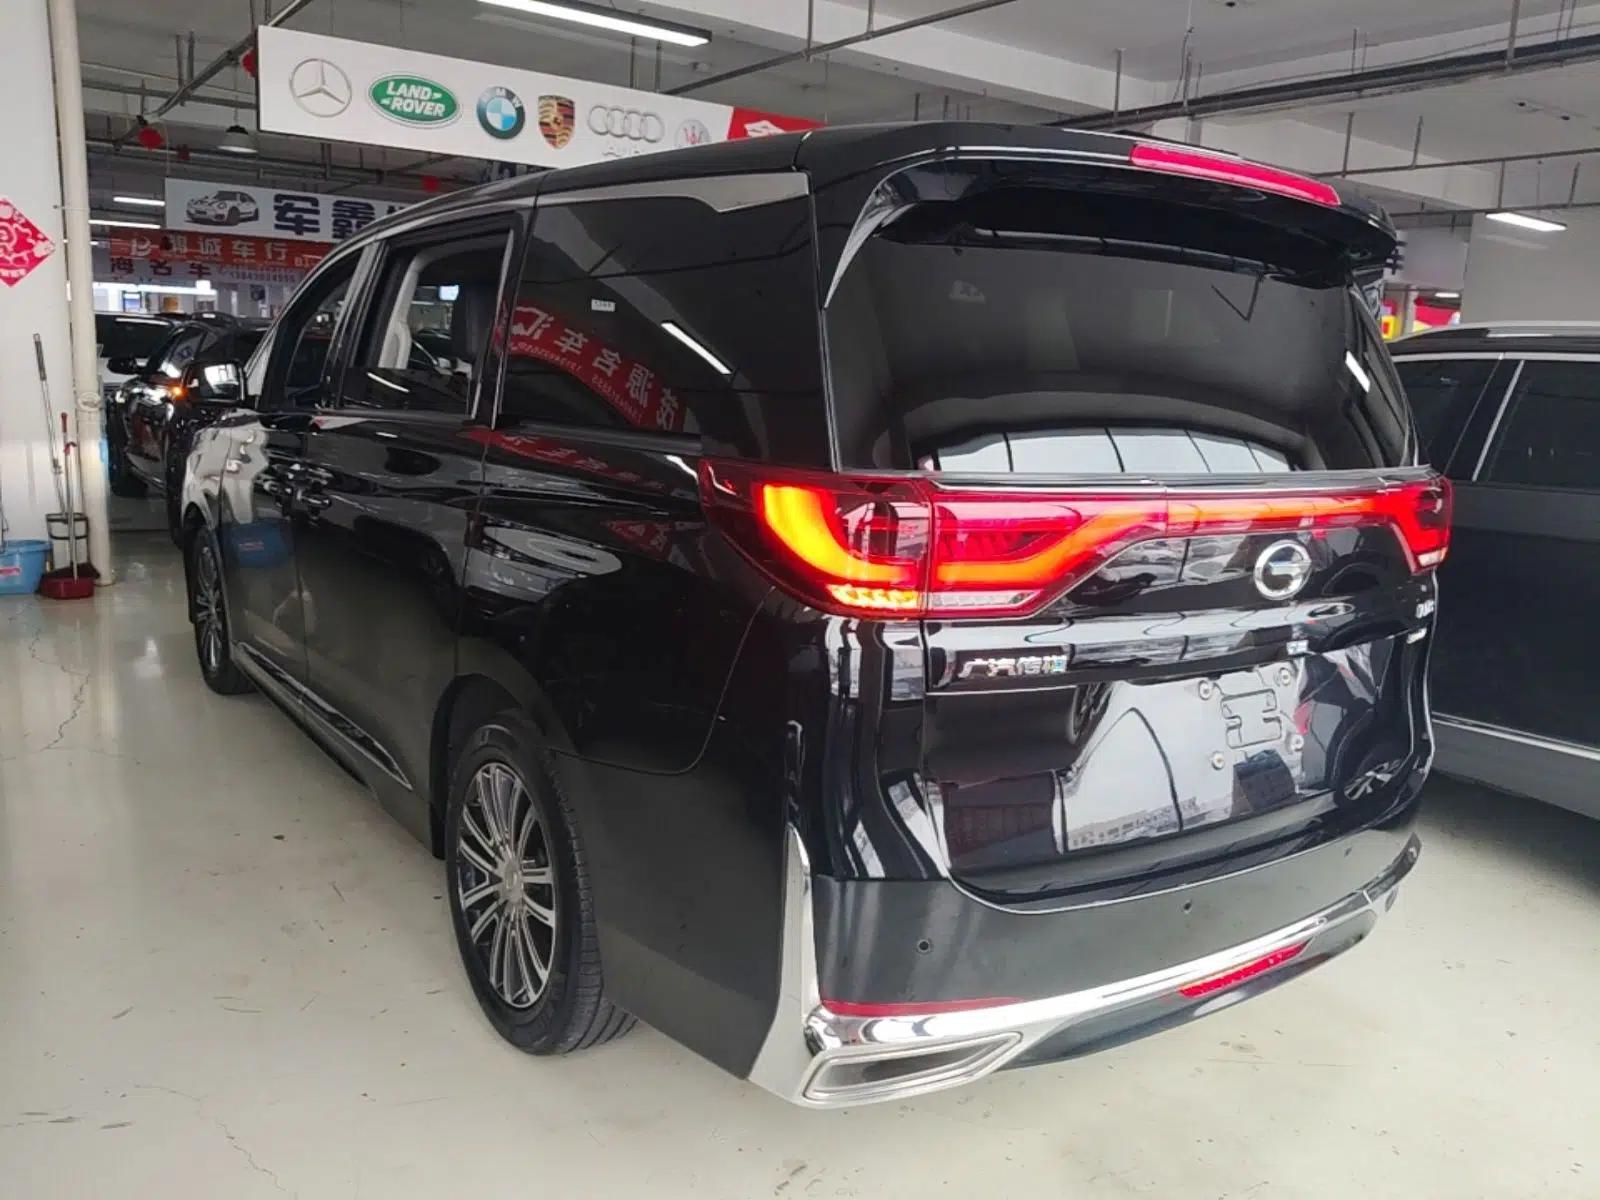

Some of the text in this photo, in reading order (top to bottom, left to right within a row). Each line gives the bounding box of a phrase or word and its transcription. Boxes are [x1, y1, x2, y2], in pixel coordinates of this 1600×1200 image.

[386, 81, 432, 100] LAND
[390, 97, 446, 117] ROVER
[273, 193, 404, 239] 军鑫
[957, 654, 1068, 678] 广汽传祺
